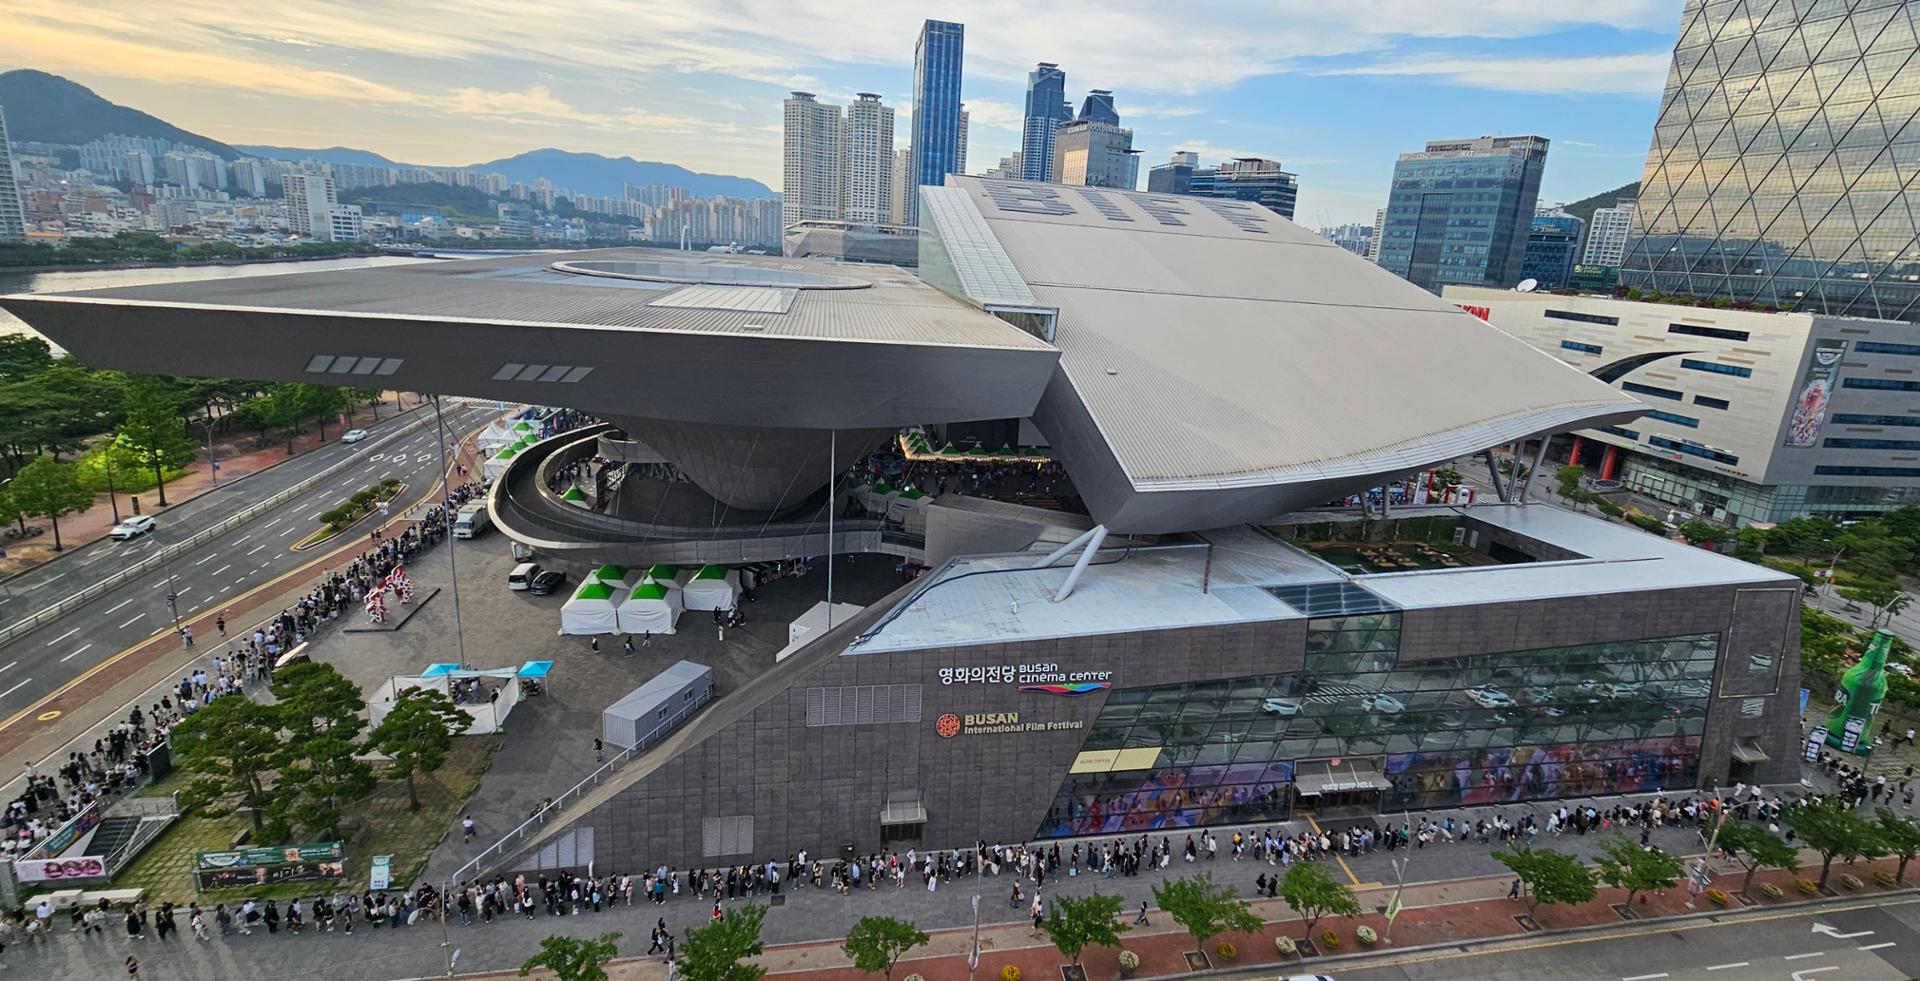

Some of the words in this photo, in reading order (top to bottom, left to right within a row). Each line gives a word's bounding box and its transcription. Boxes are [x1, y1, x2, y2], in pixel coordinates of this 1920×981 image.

[938, 665, 1016, 685] 영화의전당
[964, 712, 1018, 725] BUSAN
[964, 723, 1024, 734] International
[1025, 722, 1045, 731] Film
[1047, 720, 1083, 730] Festival
